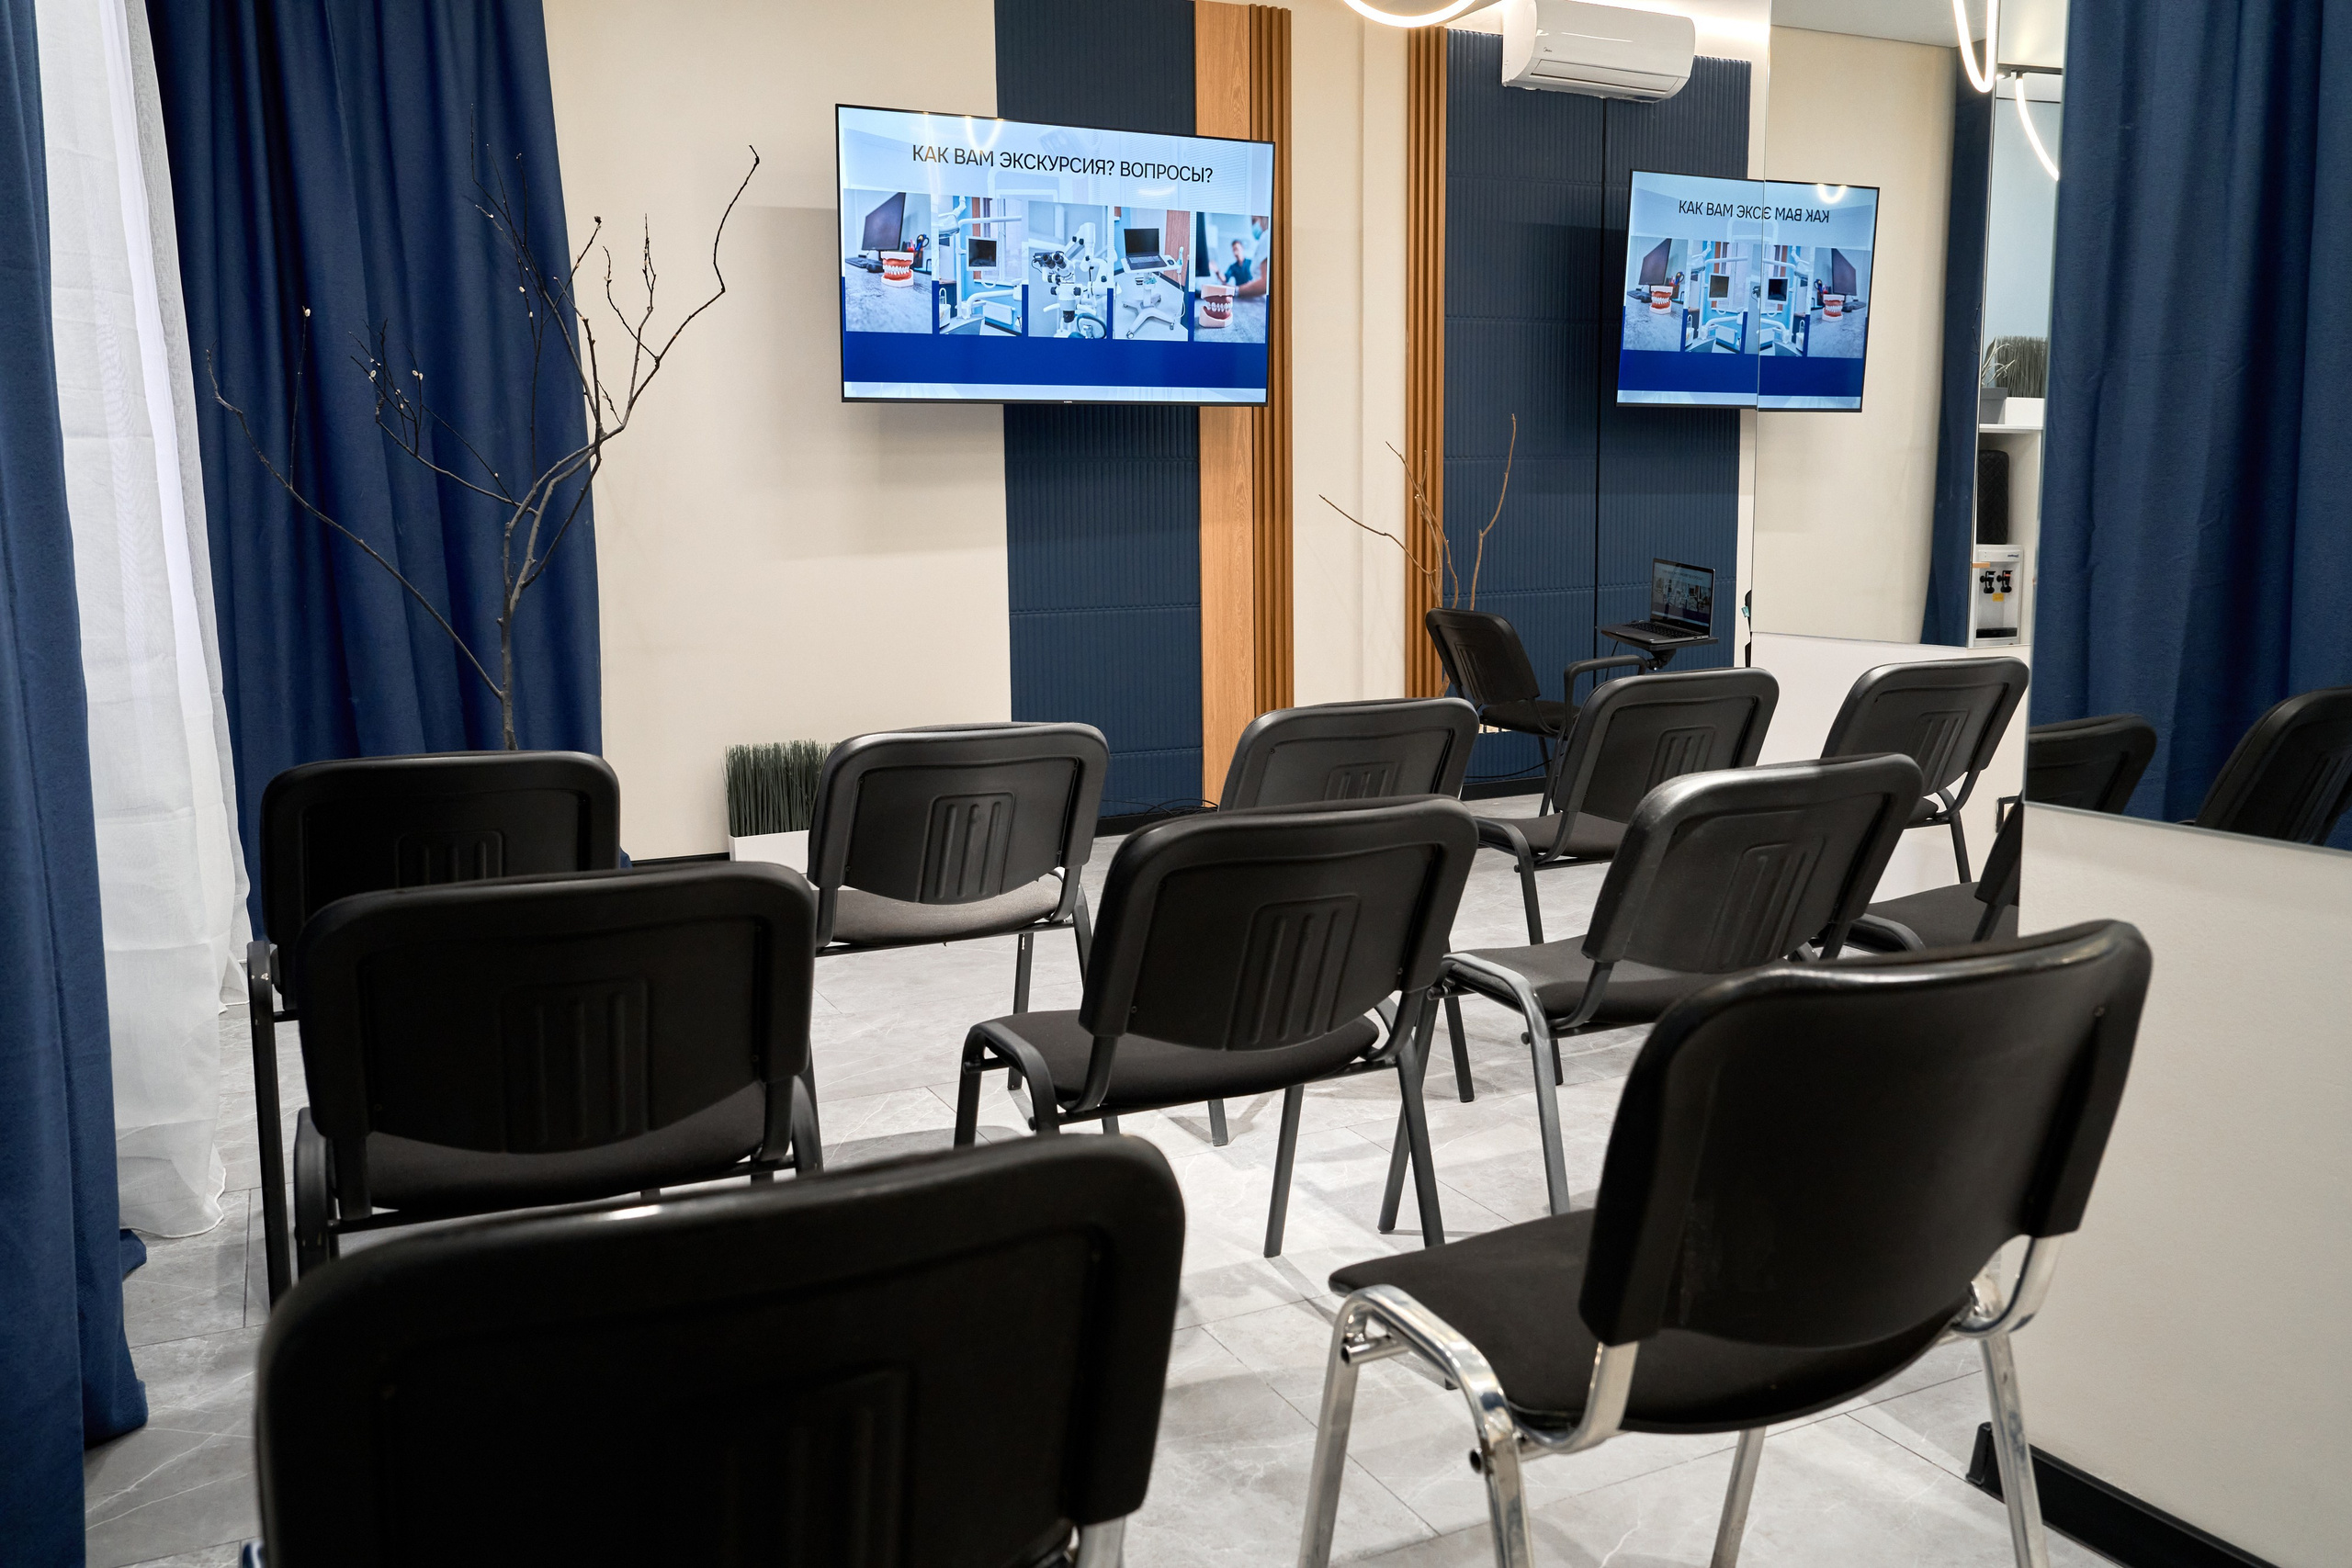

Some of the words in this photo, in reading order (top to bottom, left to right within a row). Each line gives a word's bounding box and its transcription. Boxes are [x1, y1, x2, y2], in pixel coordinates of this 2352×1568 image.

[912, 144, 949, 164] КАК
[954, 148, 994, 166] ВАМ
[1000, 152, 1114, 176] ЭКСКУРСИЯ?
[1120, 161, 1214, 183] ВОПРОСЫ?
[1679, 199, 1703, 215] КАК
[1706, 202, 1733, 218] ВАМ
[1736, 205, 1763, 220] ЭКС
